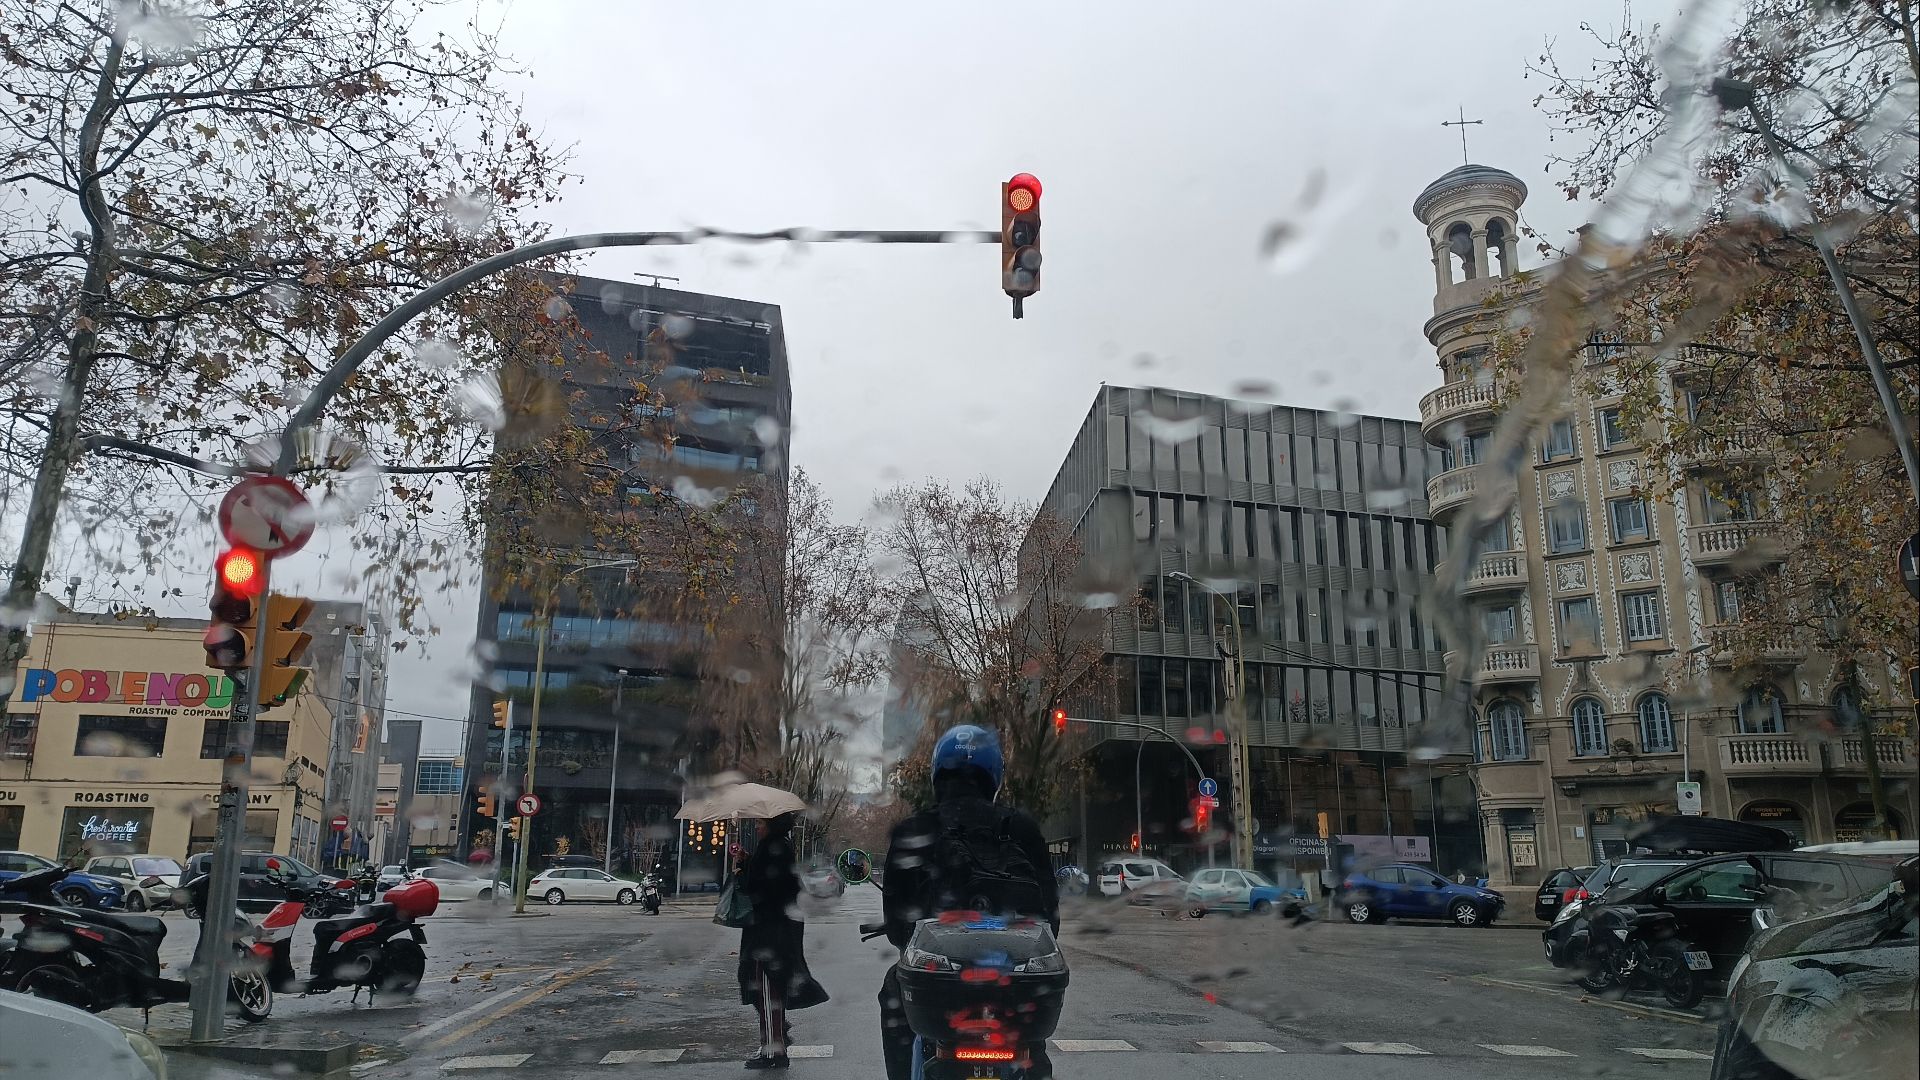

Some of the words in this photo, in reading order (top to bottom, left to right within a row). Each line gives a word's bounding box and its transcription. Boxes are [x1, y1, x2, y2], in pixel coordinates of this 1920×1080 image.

[22, 668, 234, 708] POBLENOU
[128, 706, 178, 716] ROASTING
[182, 708, 231, 718] COMPANY
[74, 792, 150, 803] ROASTING
[203, 793, 273, 804] CONY
[78, 815, 109, 840] fresh
[88, 832, 132, 842] COFFEE
[1289, 838, 1325, 847] OFICINAS
